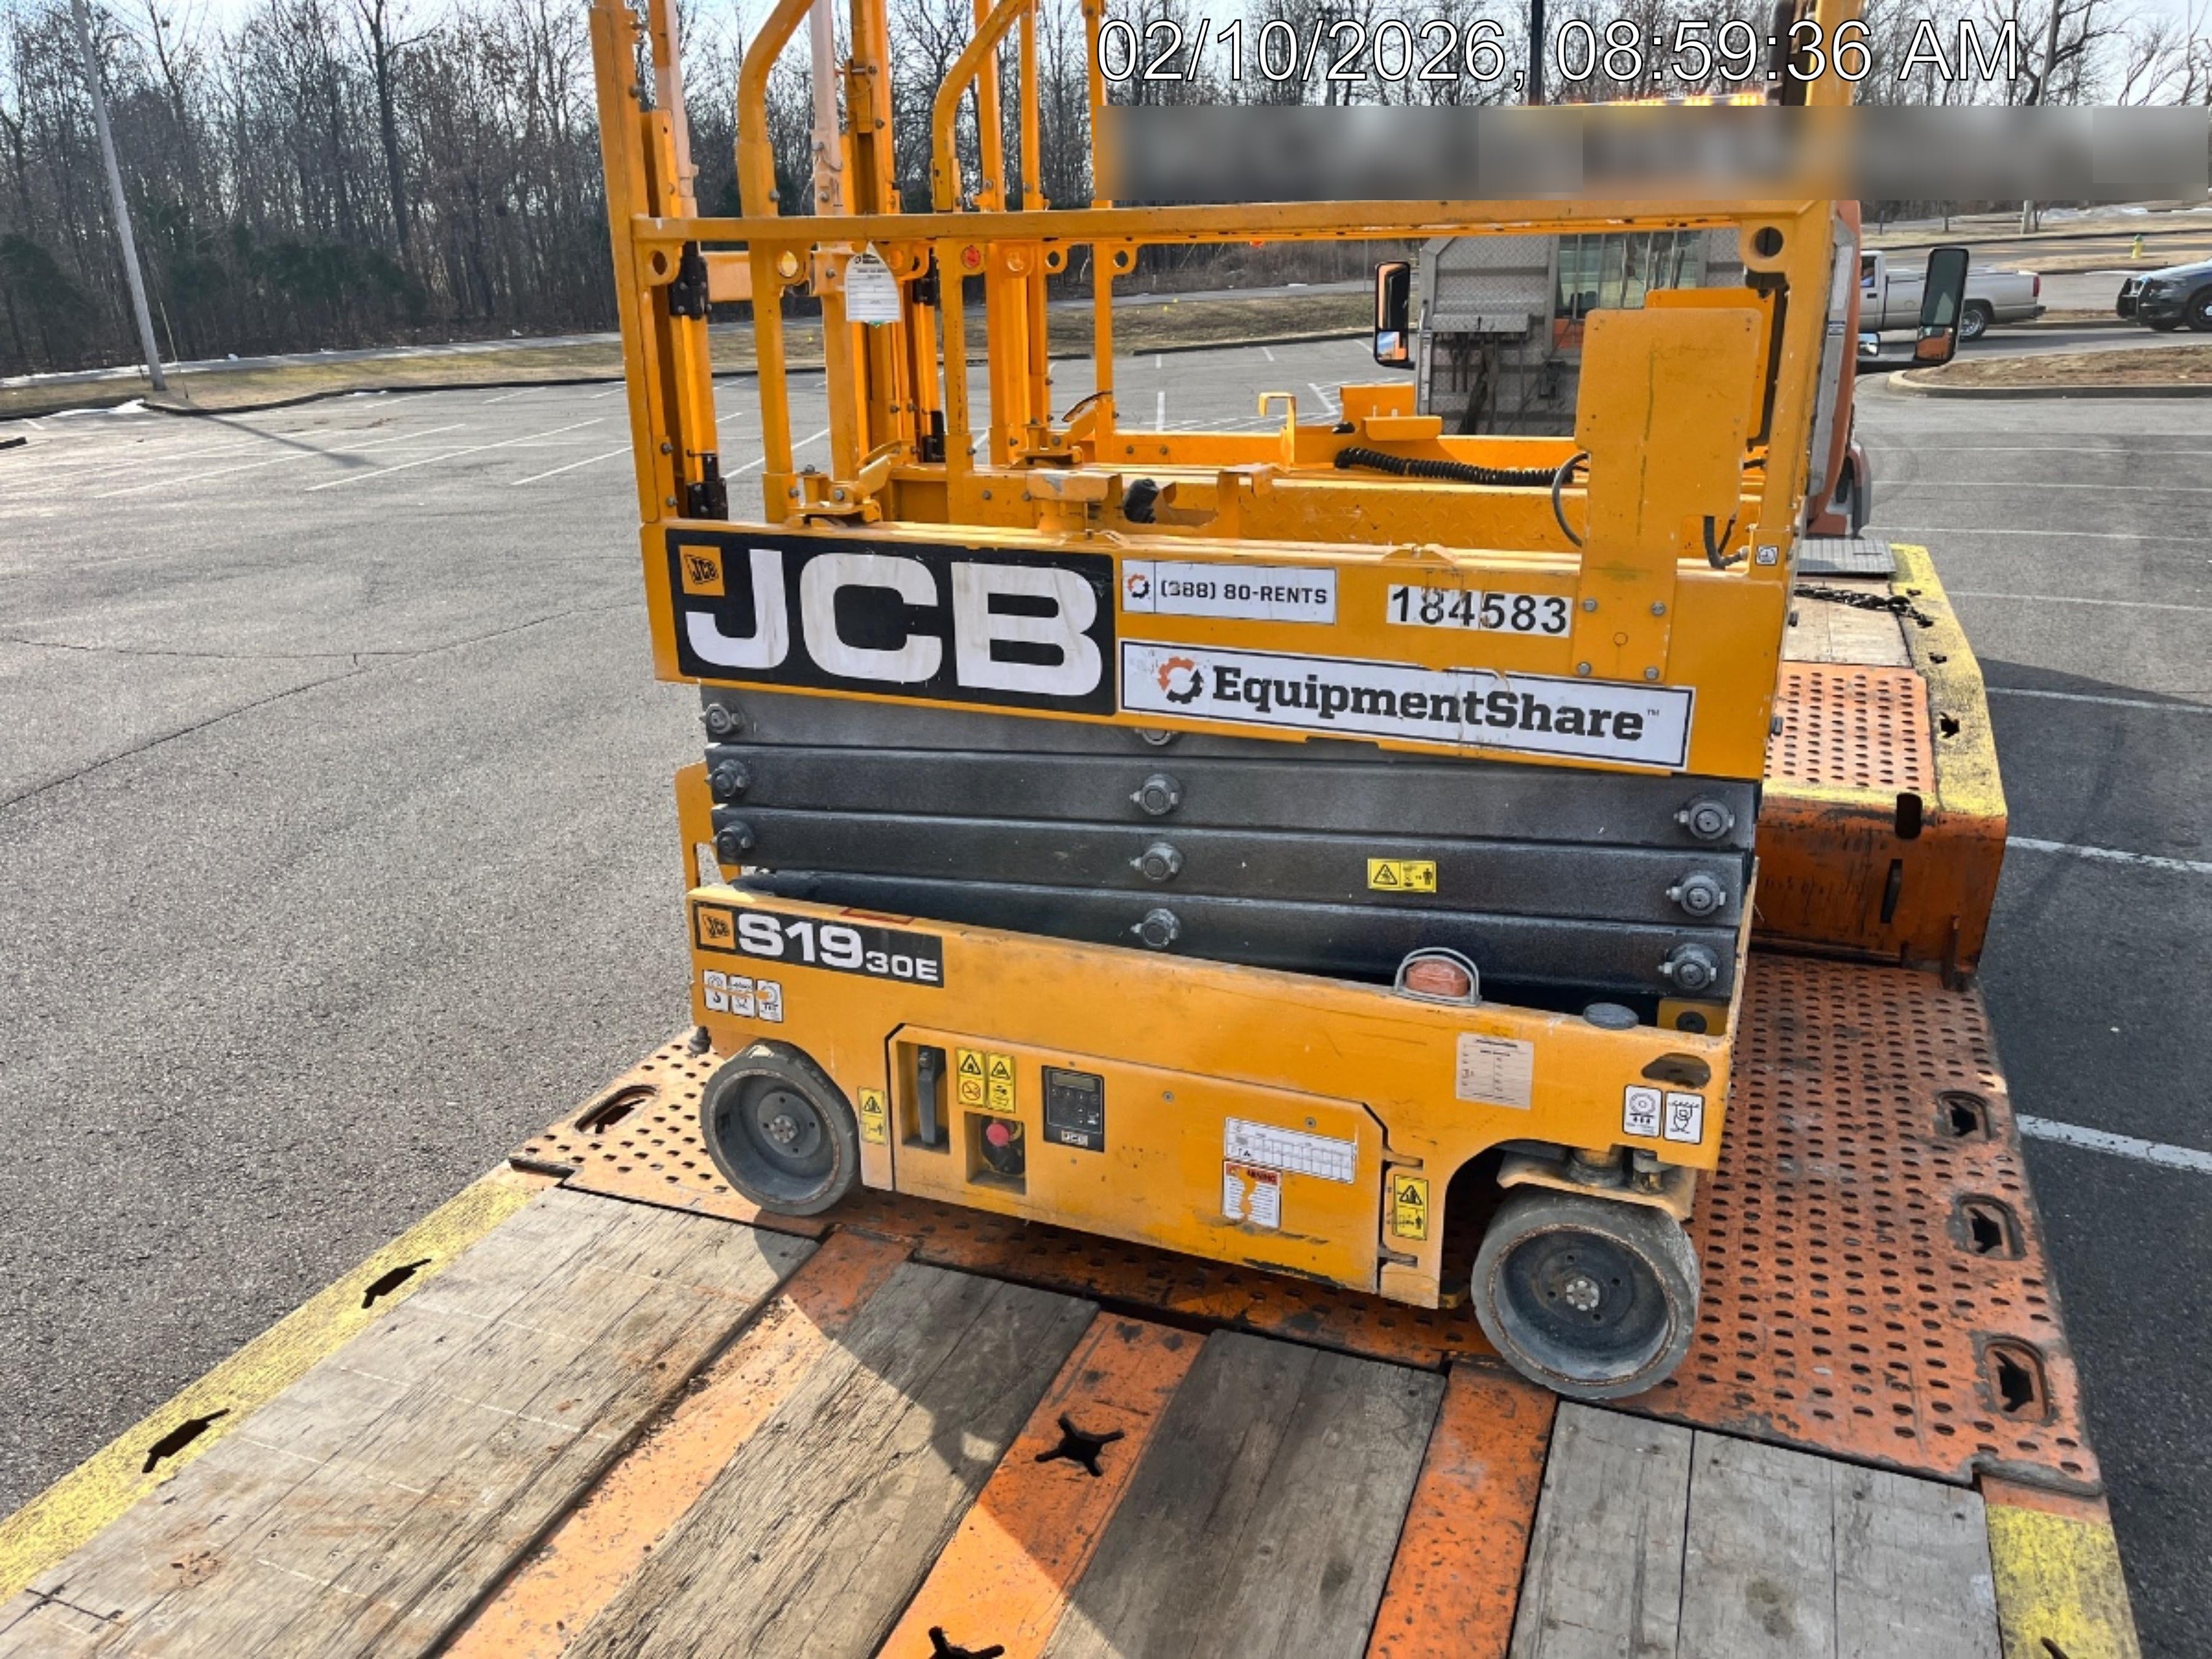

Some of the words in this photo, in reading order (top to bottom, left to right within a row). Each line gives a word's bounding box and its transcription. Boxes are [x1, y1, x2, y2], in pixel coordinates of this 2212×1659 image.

[1223, 584, 1328, 605] 80-RENTS
[1392, 586, 1567, 634] 184583
[686, 549, 1102, 695] JCB
